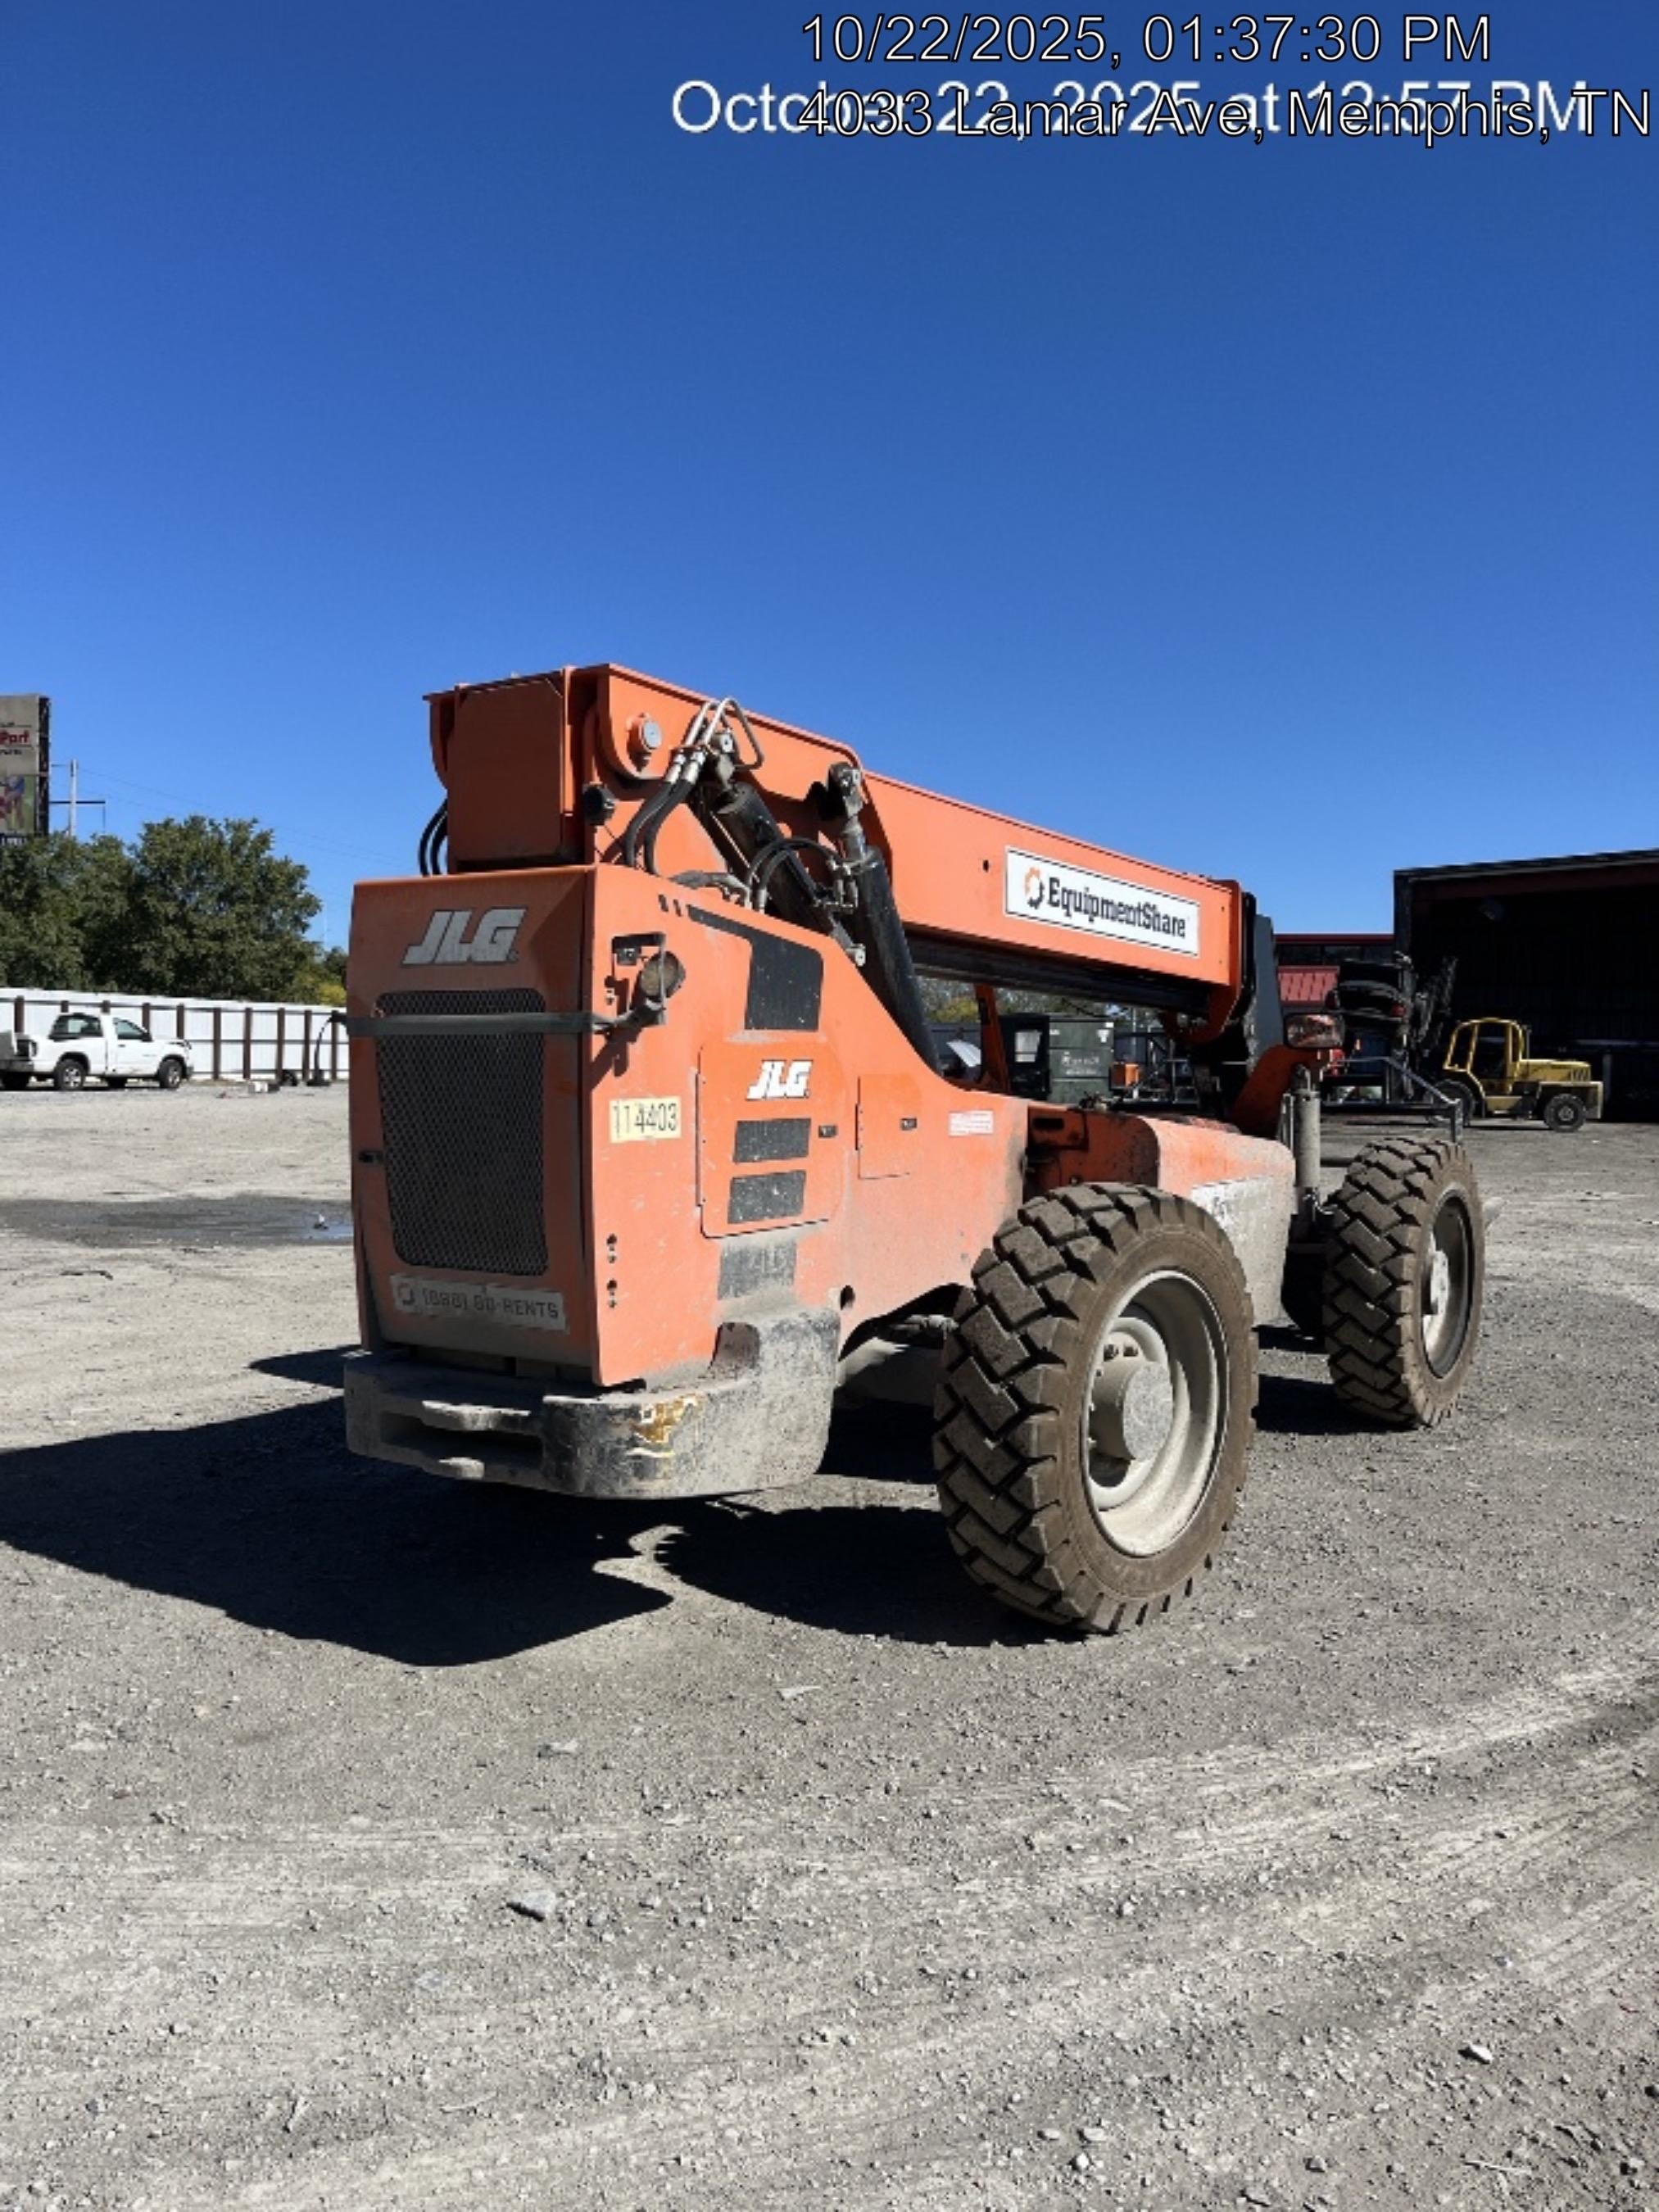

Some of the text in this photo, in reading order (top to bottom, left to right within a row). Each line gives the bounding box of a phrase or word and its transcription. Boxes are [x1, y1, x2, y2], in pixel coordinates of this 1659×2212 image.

[1047, 876, 1186, 938] EquipmentShare
[401, 907, 528, 968] JLG
[746, 1059, 813, 1100] JLG
[613, 1101, 678, 1137] 114403
